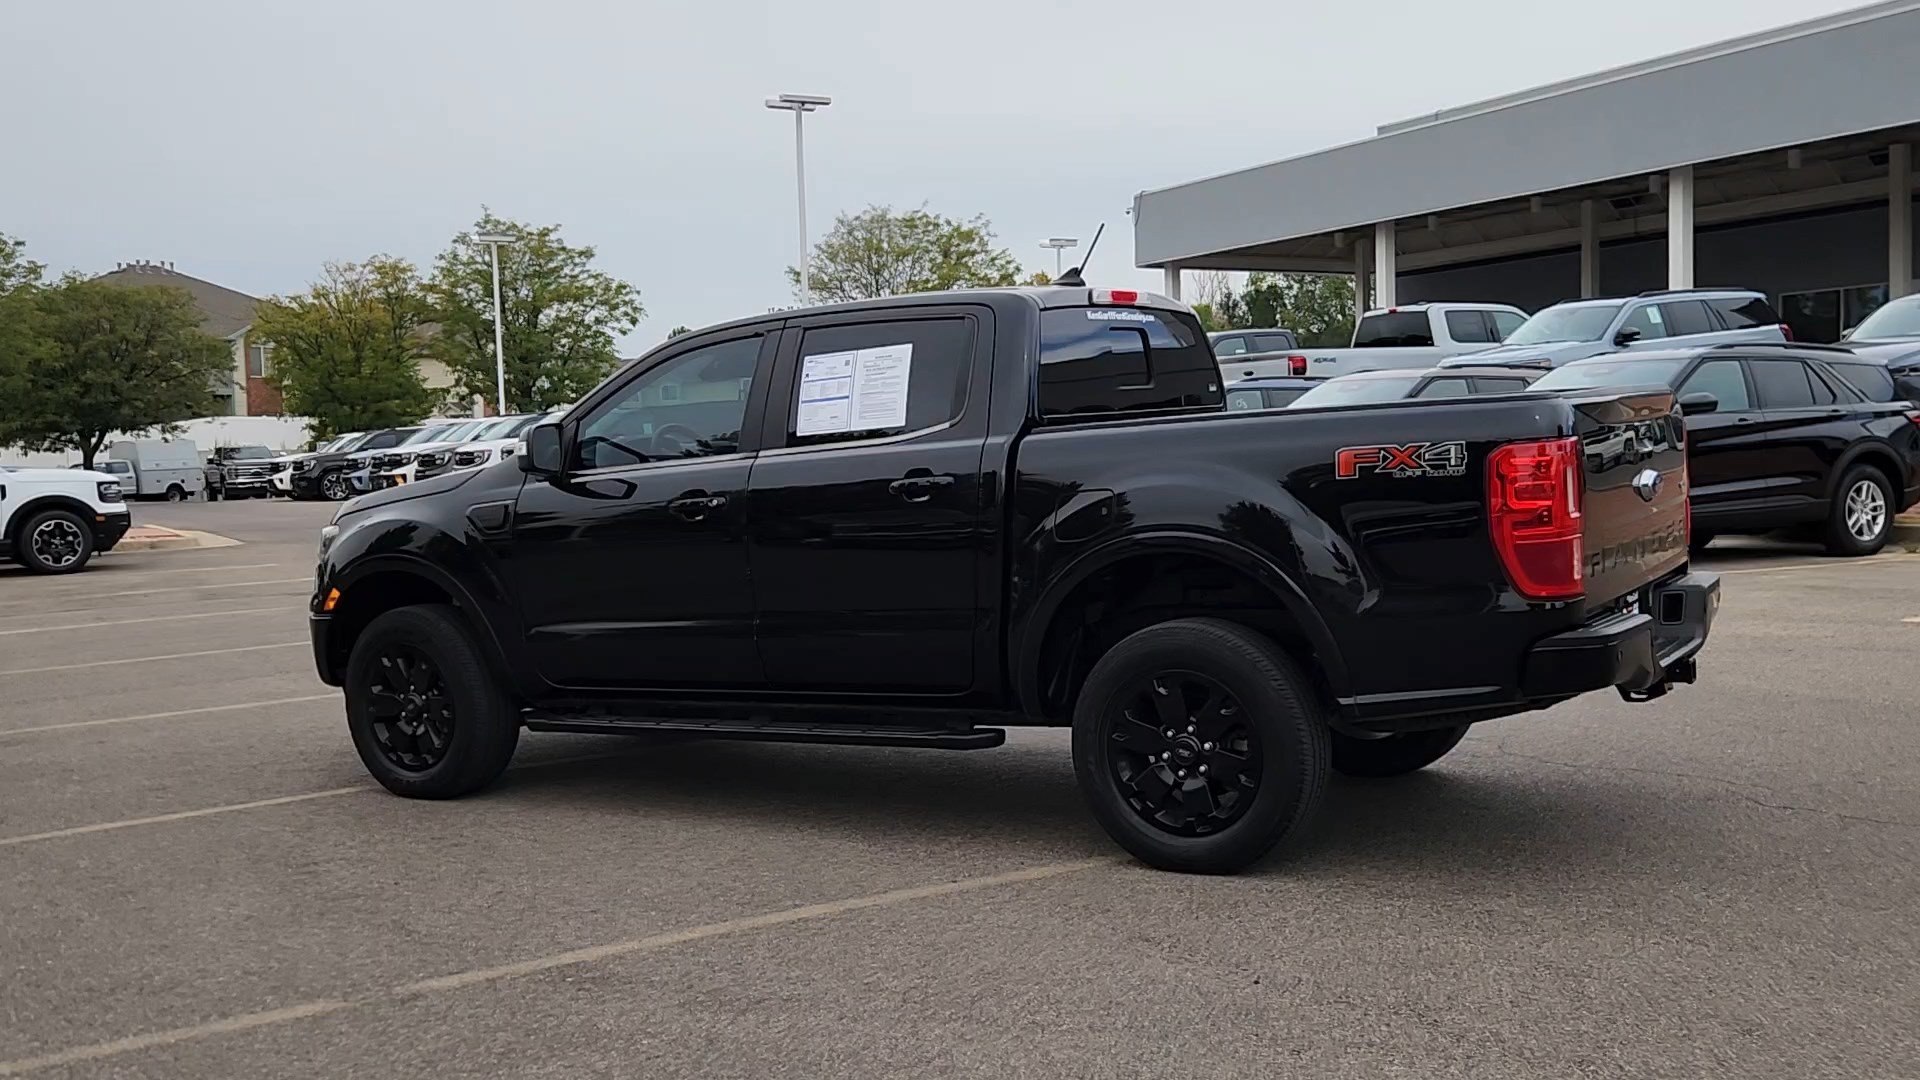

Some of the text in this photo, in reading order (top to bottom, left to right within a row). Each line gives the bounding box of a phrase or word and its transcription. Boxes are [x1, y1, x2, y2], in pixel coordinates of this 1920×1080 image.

[1335, 440, 1468, 480] FX4
[1392, 468, 1467, 478] OFF ROAD
